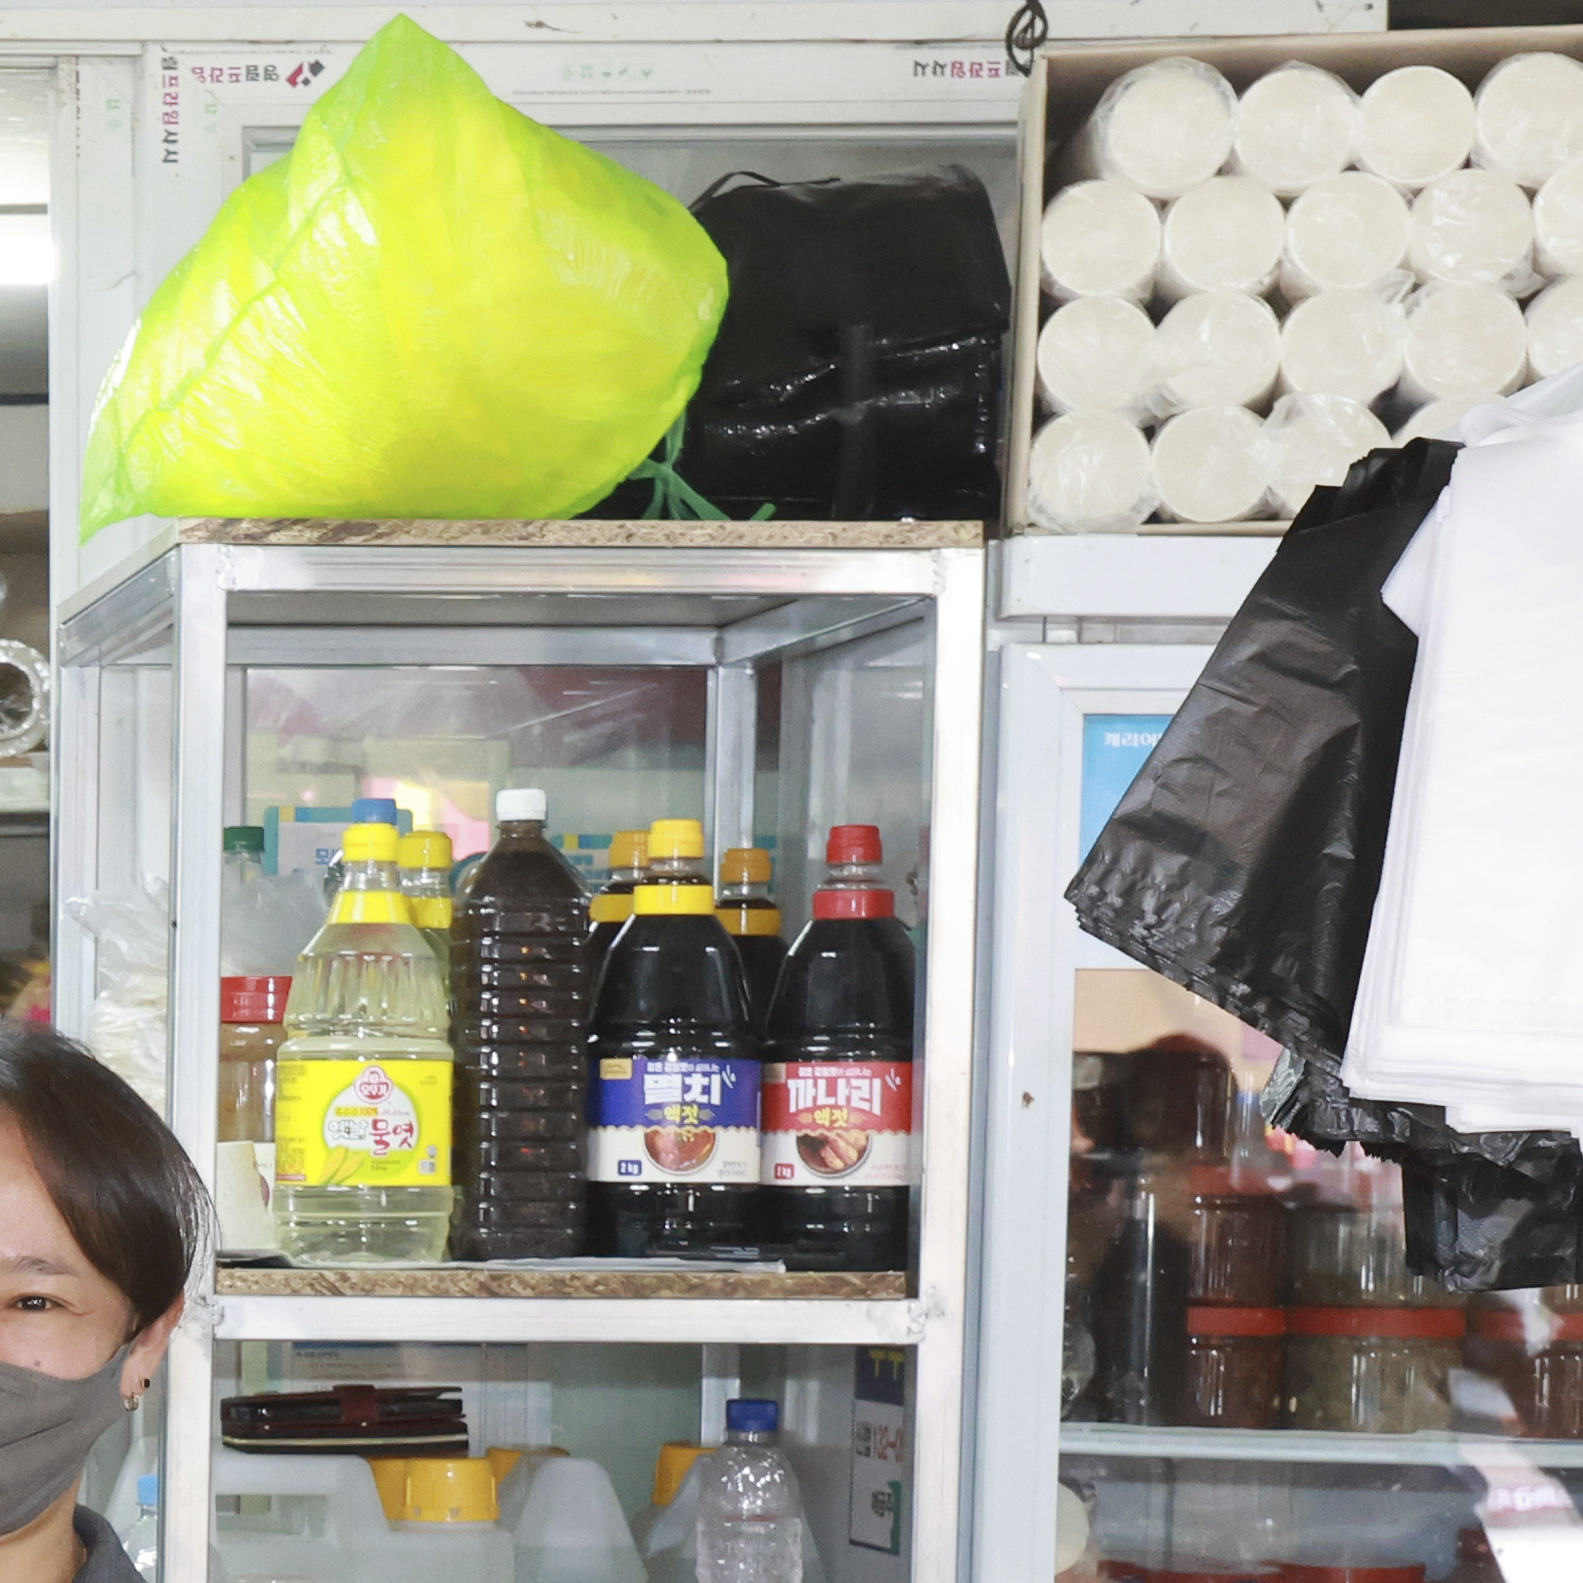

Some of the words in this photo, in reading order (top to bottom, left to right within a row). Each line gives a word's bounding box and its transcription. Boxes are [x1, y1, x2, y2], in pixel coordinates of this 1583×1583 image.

[787, 1077, 883, 1117] 까나리
[663, 1103, 700, 1126] 액젓
[813, 1107, 849, 1128] 액젓
[370, 1118, 414, 1156] 물엿
